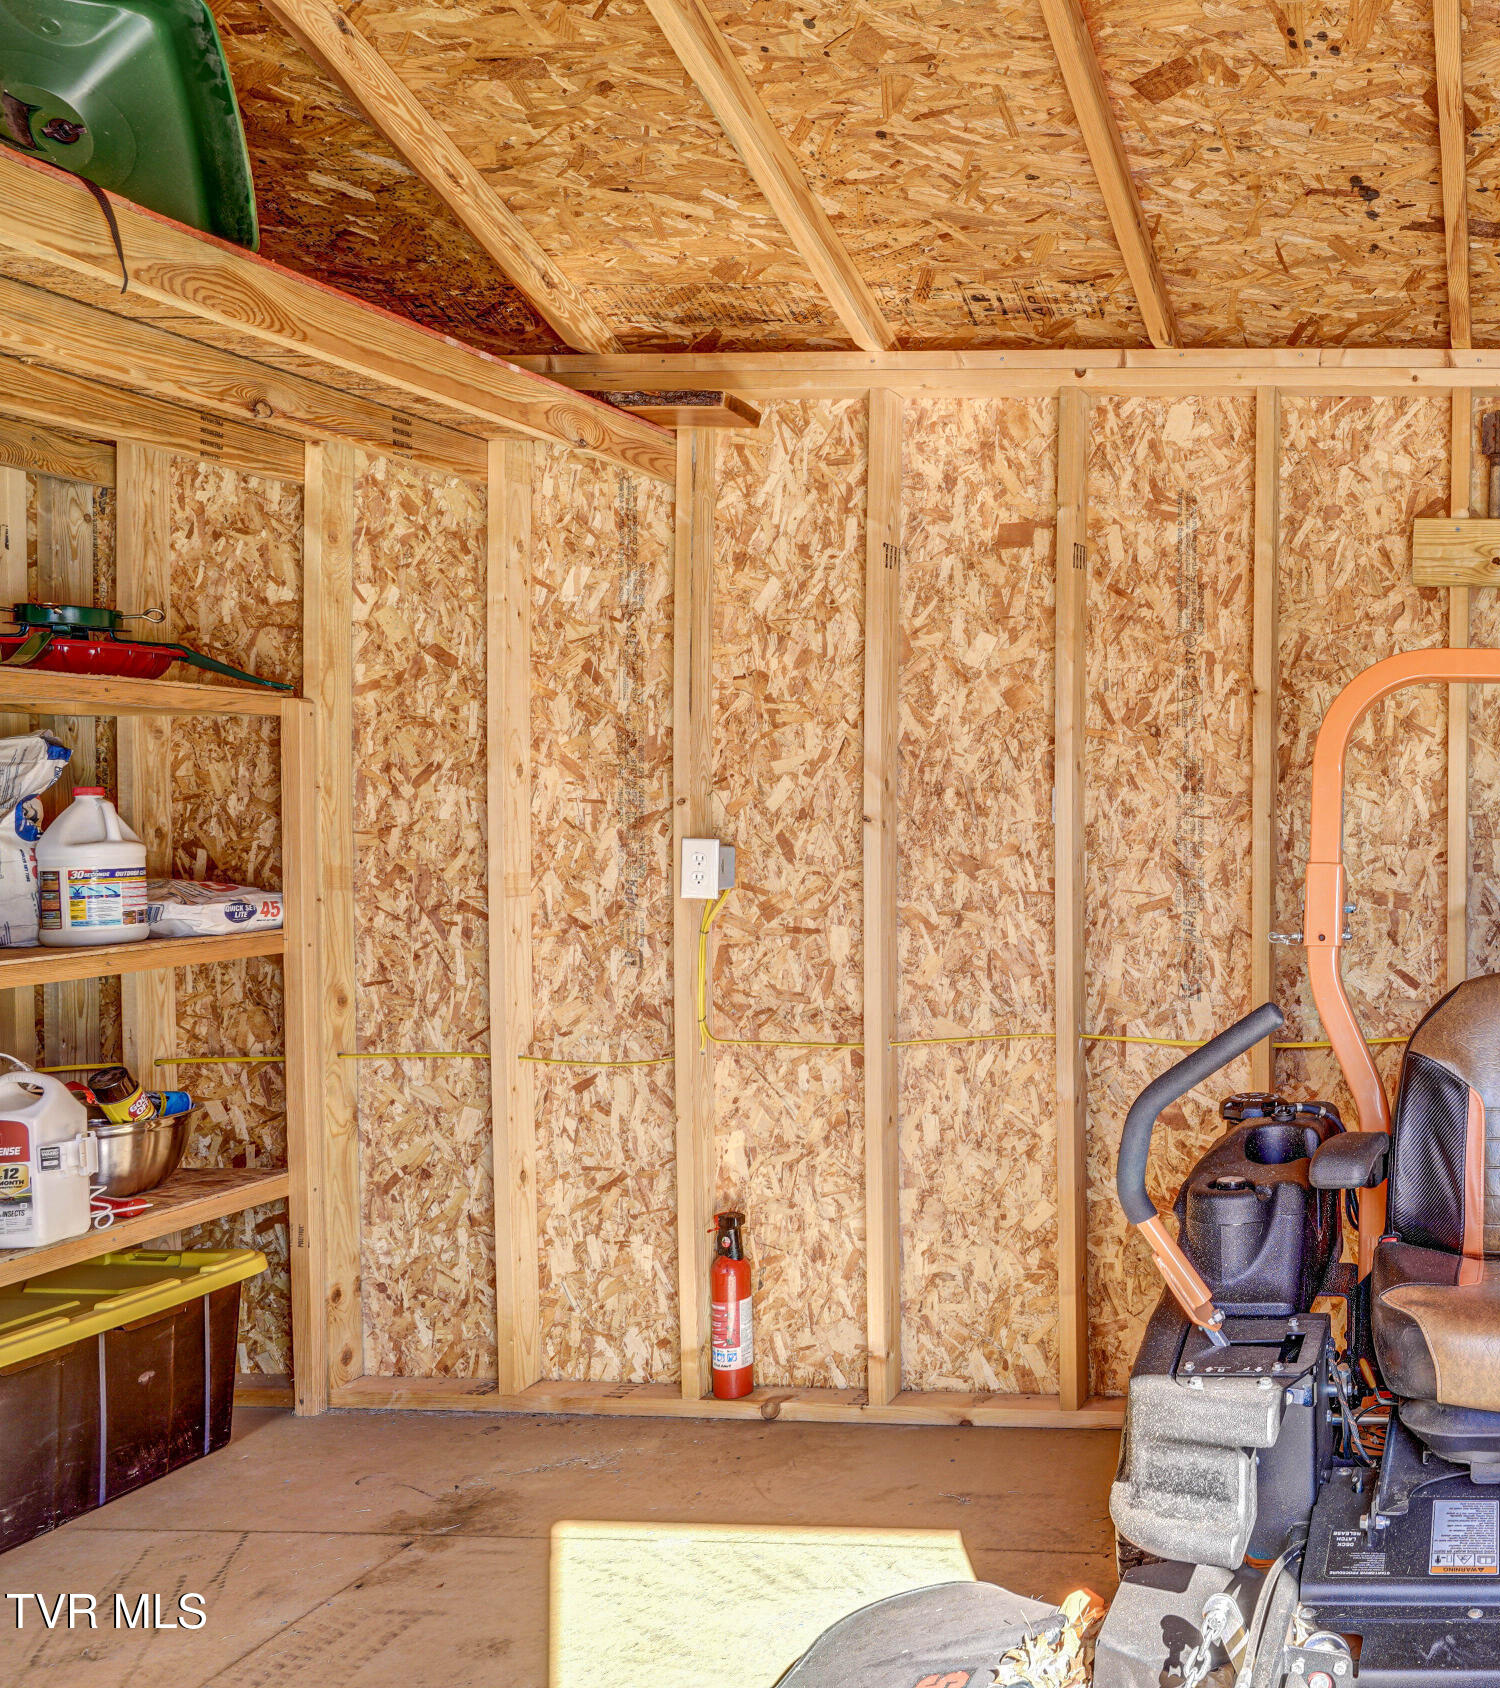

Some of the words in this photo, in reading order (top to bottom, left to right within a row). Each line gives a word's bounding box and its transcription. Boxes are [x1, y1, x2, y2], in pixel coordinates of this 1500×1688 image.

[70, 870, 84, 879] 30
[224, 904, 244, 912] QUICK
[260, 900, 281, 918] 45
[3, 1167, 20, 1179] 12
[2, 1209, 25, 1218] INSECTS
